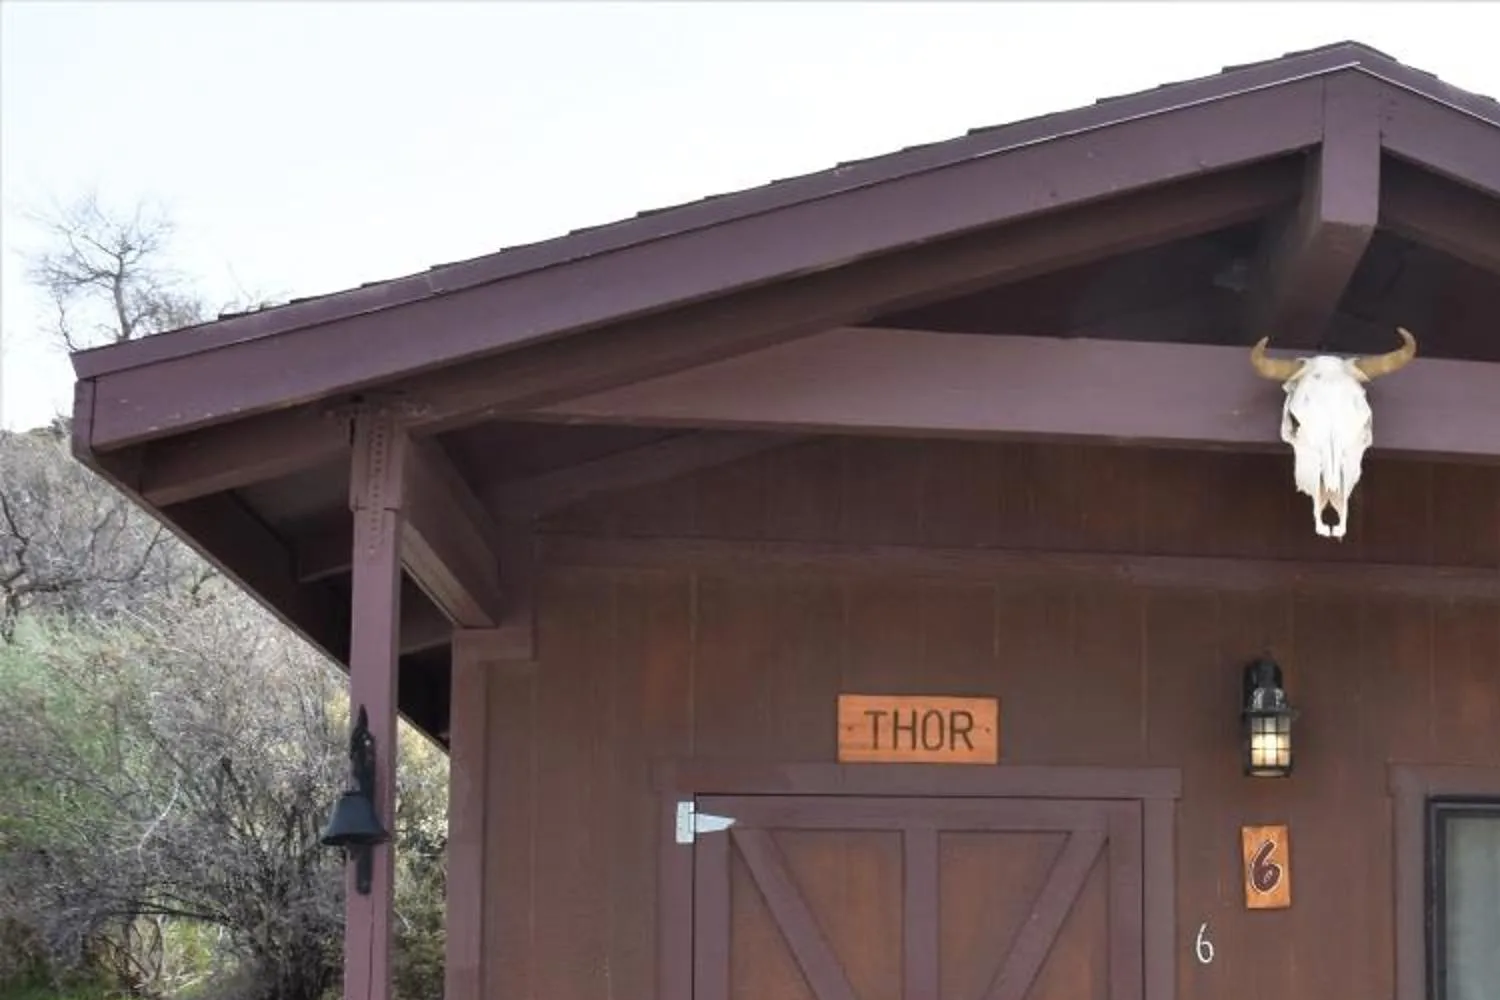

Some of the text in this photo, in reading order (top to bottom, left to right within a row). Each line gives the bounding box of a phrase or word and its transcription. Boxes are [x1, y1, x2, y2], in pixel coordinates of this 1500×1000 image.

[863, 708, 975, 752] THOR
[1251, 839, 1283, 894] 6
[1196, 922, 1214, 964] 6
